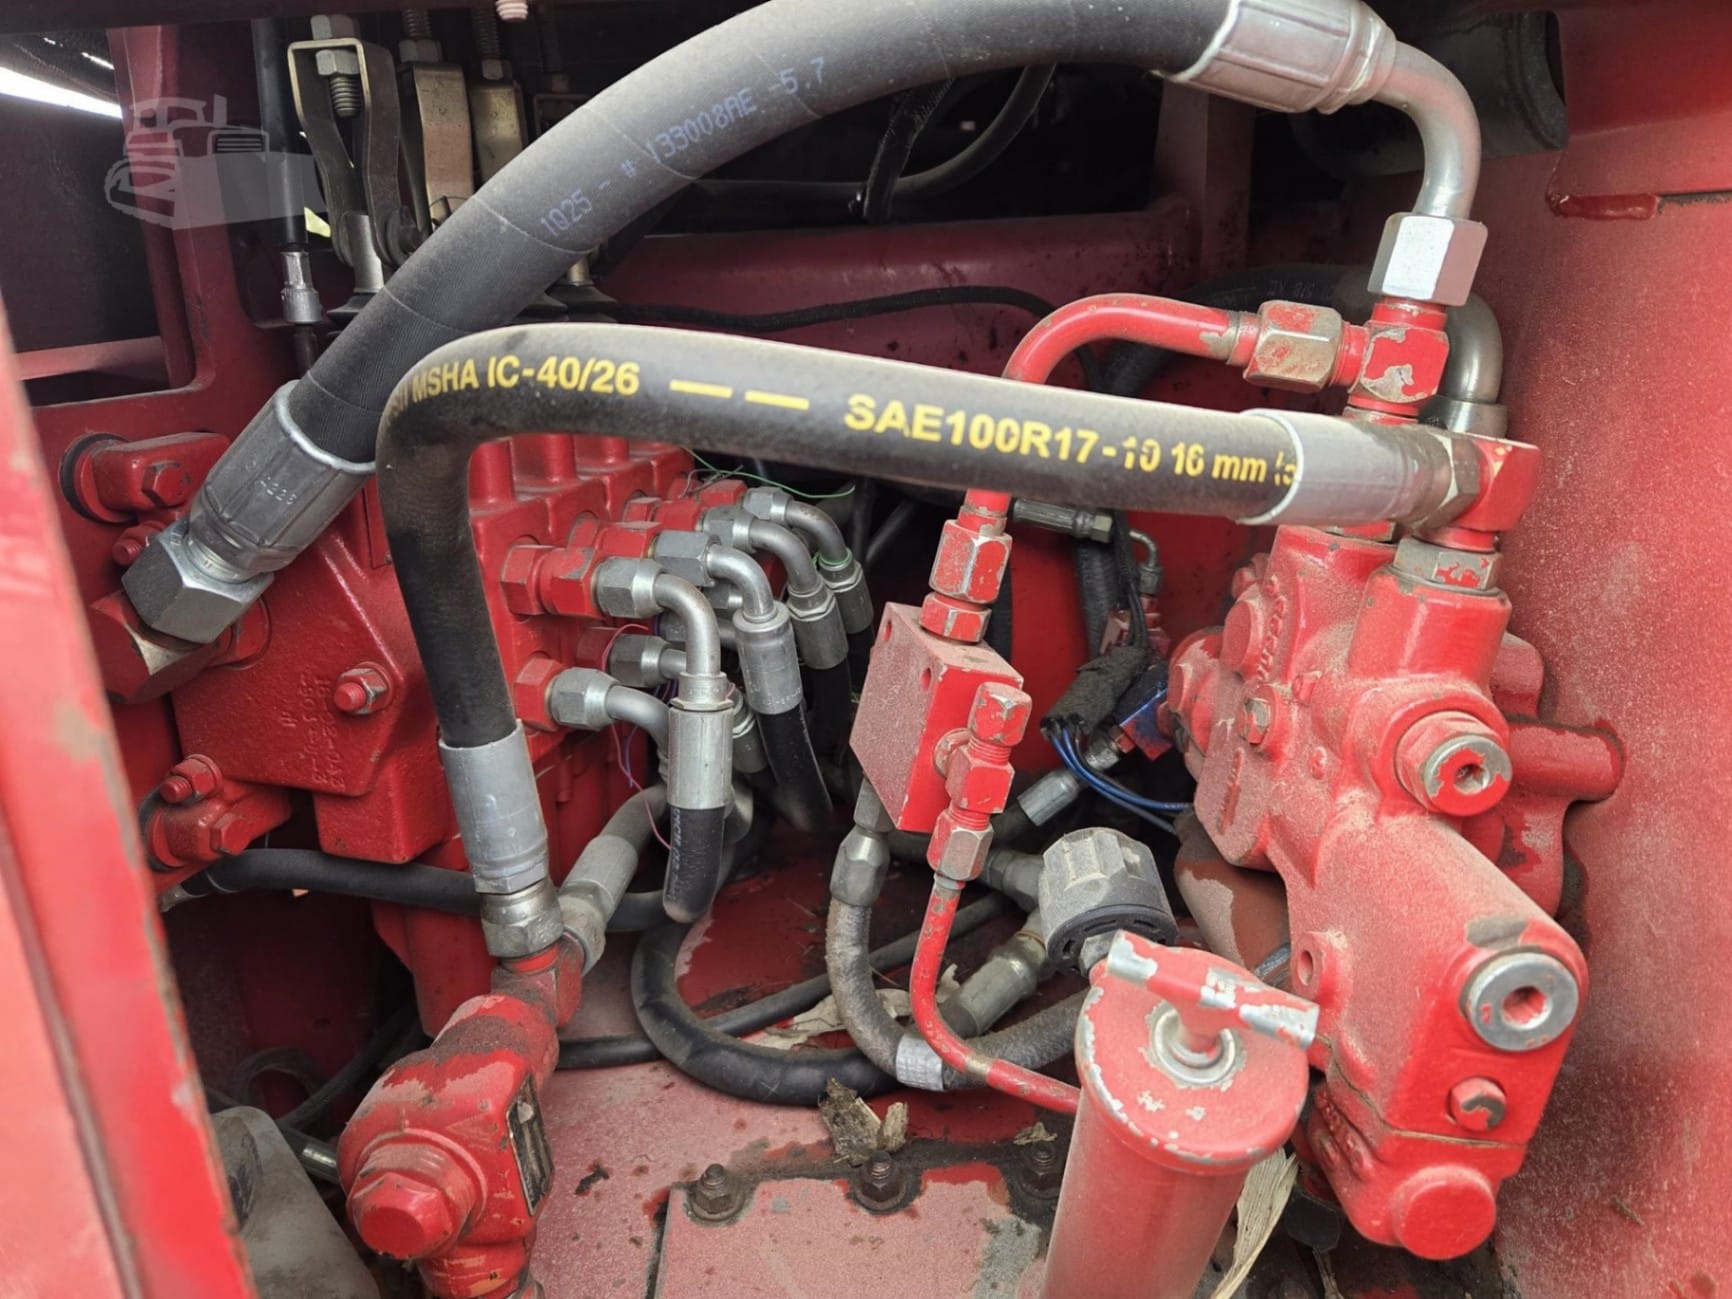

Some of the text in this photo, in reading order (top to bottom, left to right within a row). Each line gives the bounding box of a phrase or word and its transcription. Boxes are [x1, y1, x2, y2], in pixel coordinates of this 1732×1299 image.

[411, 357, 480, 404] MSHA
[487, 354, 641, 396] IC-40/26
[844, 393, 1161, 473] SAE100R17-10
[1170, 441, 1205, 477] 16
[1211, 453, 1267, 483] mm
